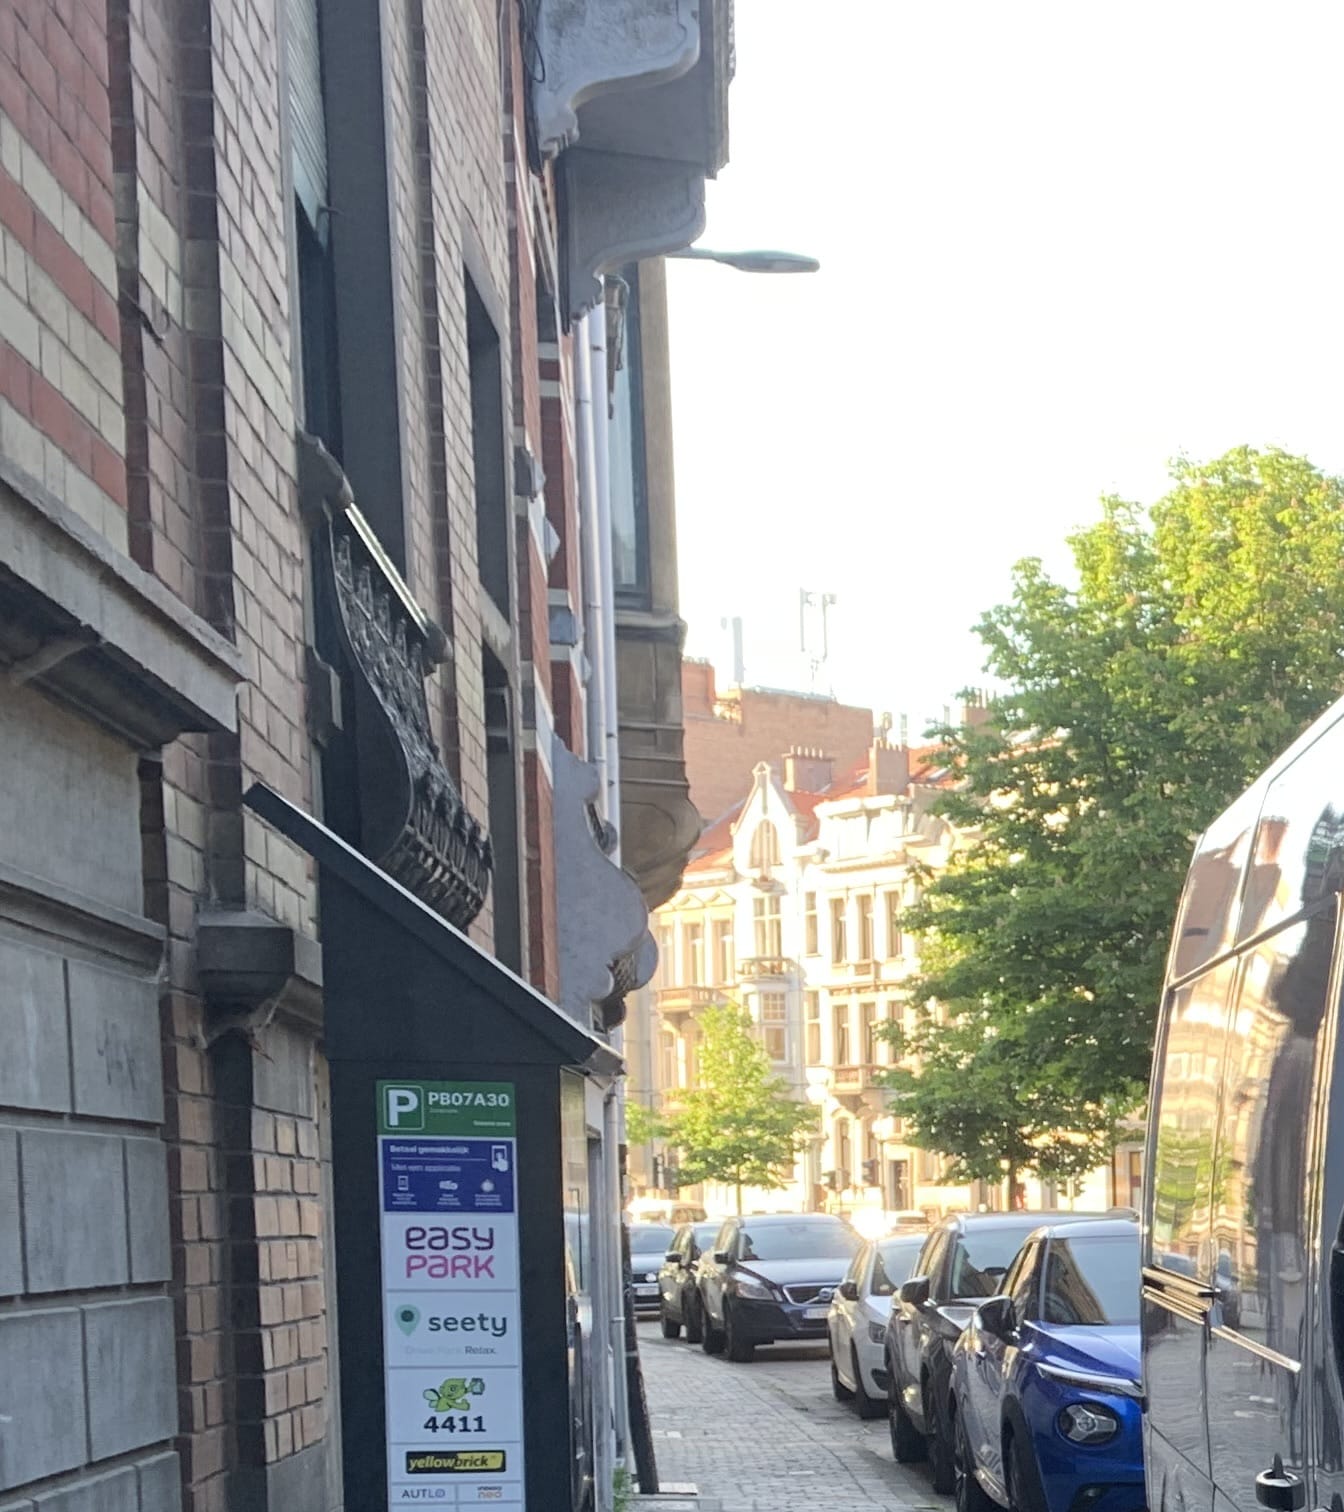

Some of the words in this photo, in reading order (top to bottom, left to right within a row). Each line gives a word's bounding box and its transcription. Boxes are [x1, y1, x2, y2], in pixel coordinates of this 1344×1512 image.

[388, 1089, 418, 1126] P
[427, 1091, 510, 1107] PB07A30
[405, 1226, 494, 1250] easy
[428, 1313, 507, 1337] seety
[423, 1415, 487, 1433] 4411
[408, 1455, 489, 1472] yellowbrick
